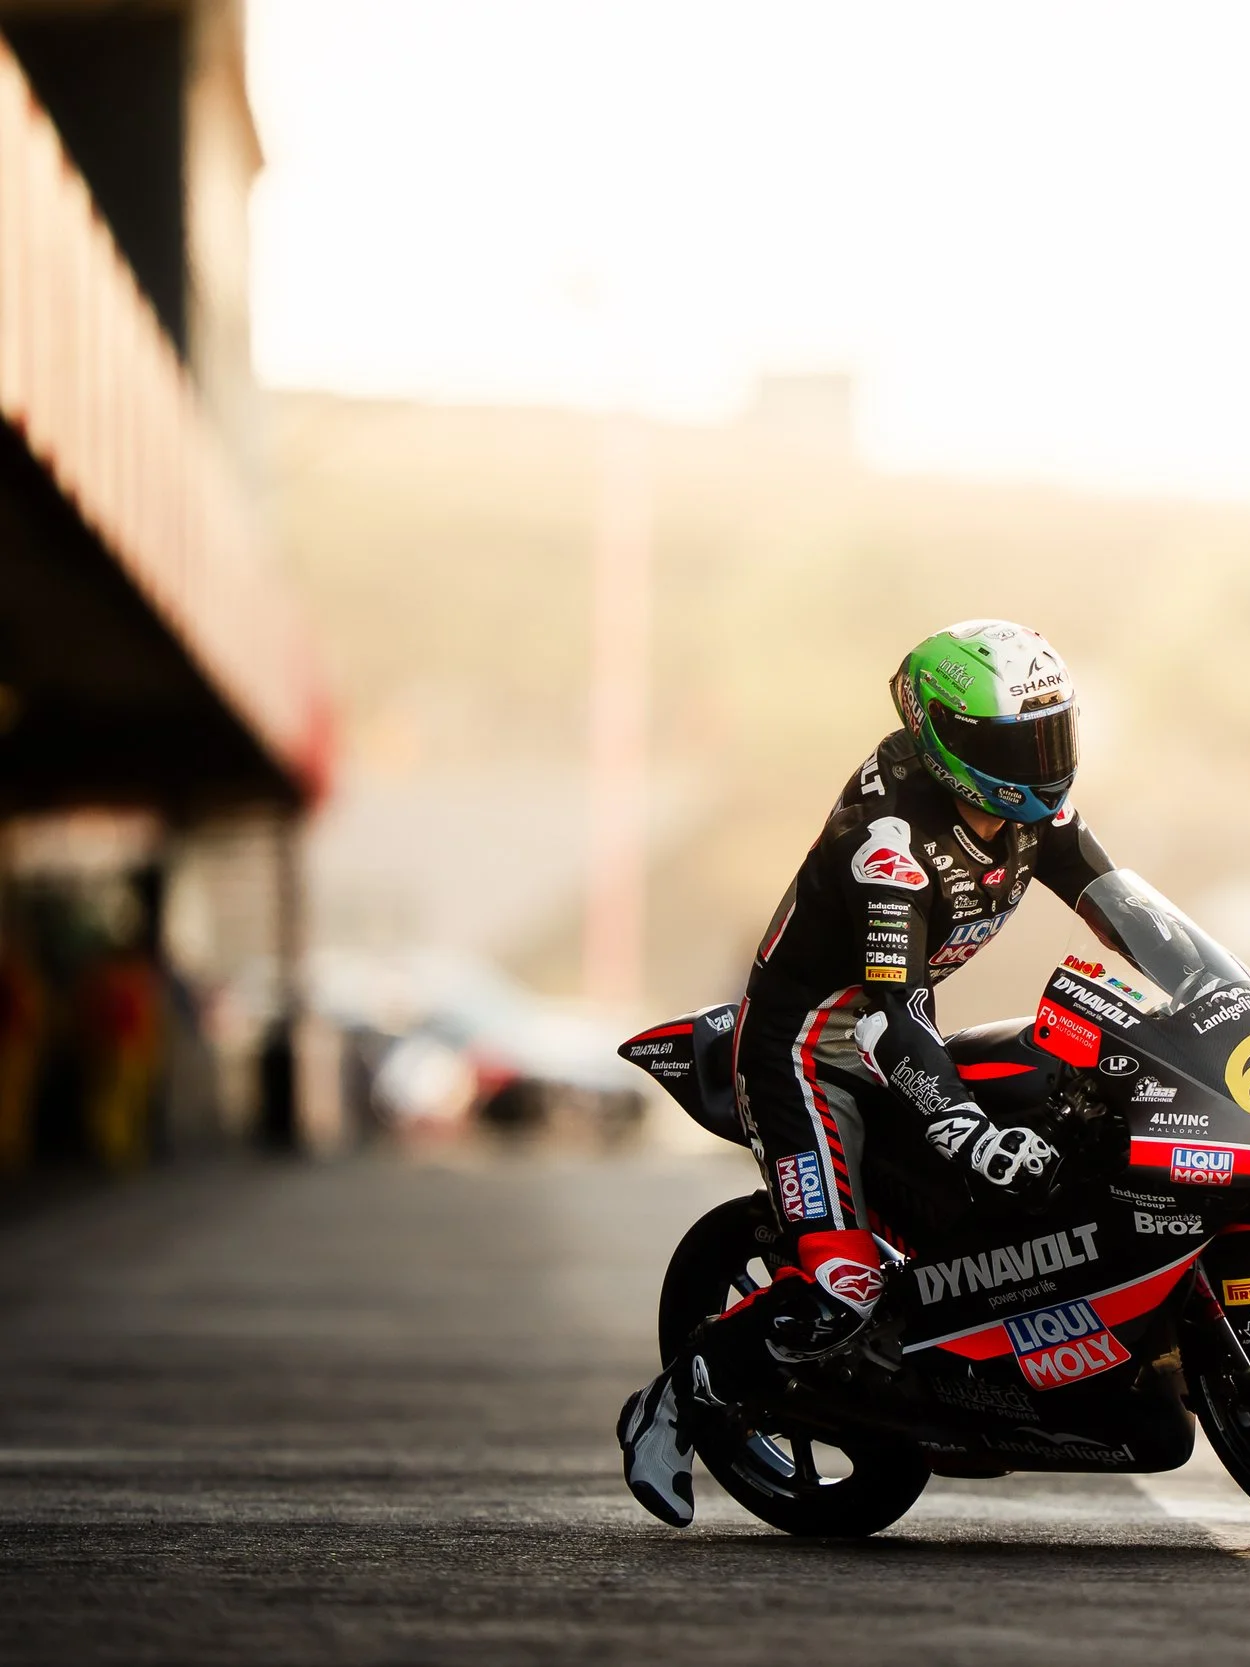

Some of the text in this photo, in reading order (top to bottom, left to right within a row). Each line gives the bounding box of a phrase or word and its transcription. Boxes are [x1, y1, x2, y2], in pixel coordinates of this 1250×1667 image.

[1009, 673, 1064, 697] SHARK
[954, 714, 979, 725] SHARK
[923, 753, 987, 807] SHARK
[998, 787, 1022, 799] Estrella
[951, 881, 975, 894] KTM
[868, 902, 910, 910] Inductron
[866, 932, 909, 943] 4LIVING
[875, 952, 907, 965] Beta
[867, 969, 902, 979] PIRELLI
[1052, 976, 1141, 1029] DYNAVOLT
[1038, 1005, 1058, 1026] Fb
[1055, 1024, 1093, 1049] AUTOMATION
[1060, 1015, 1098, 1042] INDUSTRY
[650, 1060, 690, 1070] Inductron
[662, 1070, 682, 1078] Group
[1109, 1058, 1128, 1071] LP
[889, 1075, 913, 1099] BATTERY
[1150, 1113, 1209, 1127] 4LIVING
[1149, 1126, 1209, 1135] MALLORCA
[1174, 1150, 1231, 1170] LIQUI
[797, 1154, 824, 1216] LIQUI
[1174, 1168, 1231, 1184] MOLY
[779, 1159, 804, 1218] MOLY
[1109, 1185, 1176, 1203] Inductron
[1135, 1200, 1165, 1210] Group
[913, 1222, 1099, 1306] DYNAVOLT
[988, 1279, 1058, 1310] power your life
[1008, 1302, 1099, 1353] LIQUI
[1024, 1334, 1118, 1387] MOLY
[980, 1432, 1137, 1466] Landgeflügel
